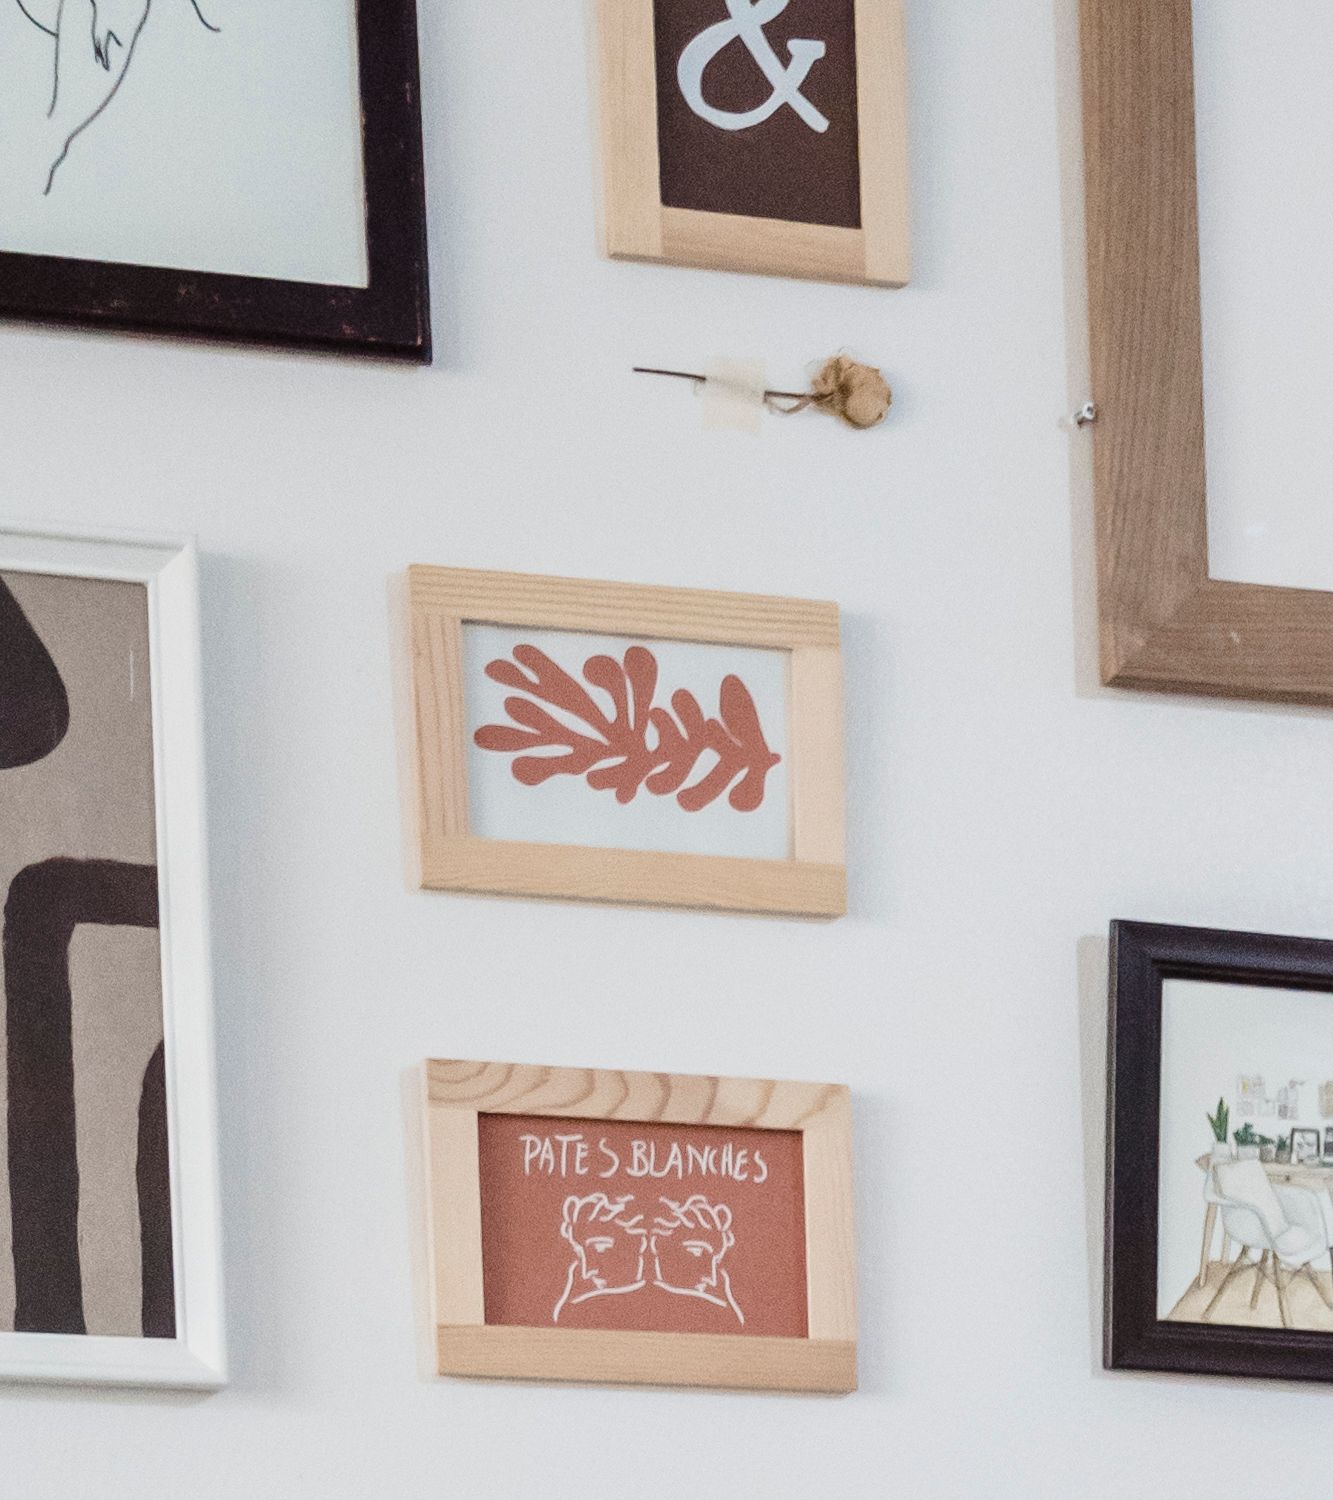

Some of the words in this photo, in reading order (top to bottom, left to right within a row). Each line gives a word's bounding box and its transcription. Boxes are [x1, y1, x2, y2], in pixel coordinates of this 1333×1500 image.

[677, 0, 829, 133] &
[519, 1133, 620, 1178] PATES
[625, 1139, 768, 1184] BLANCHES
